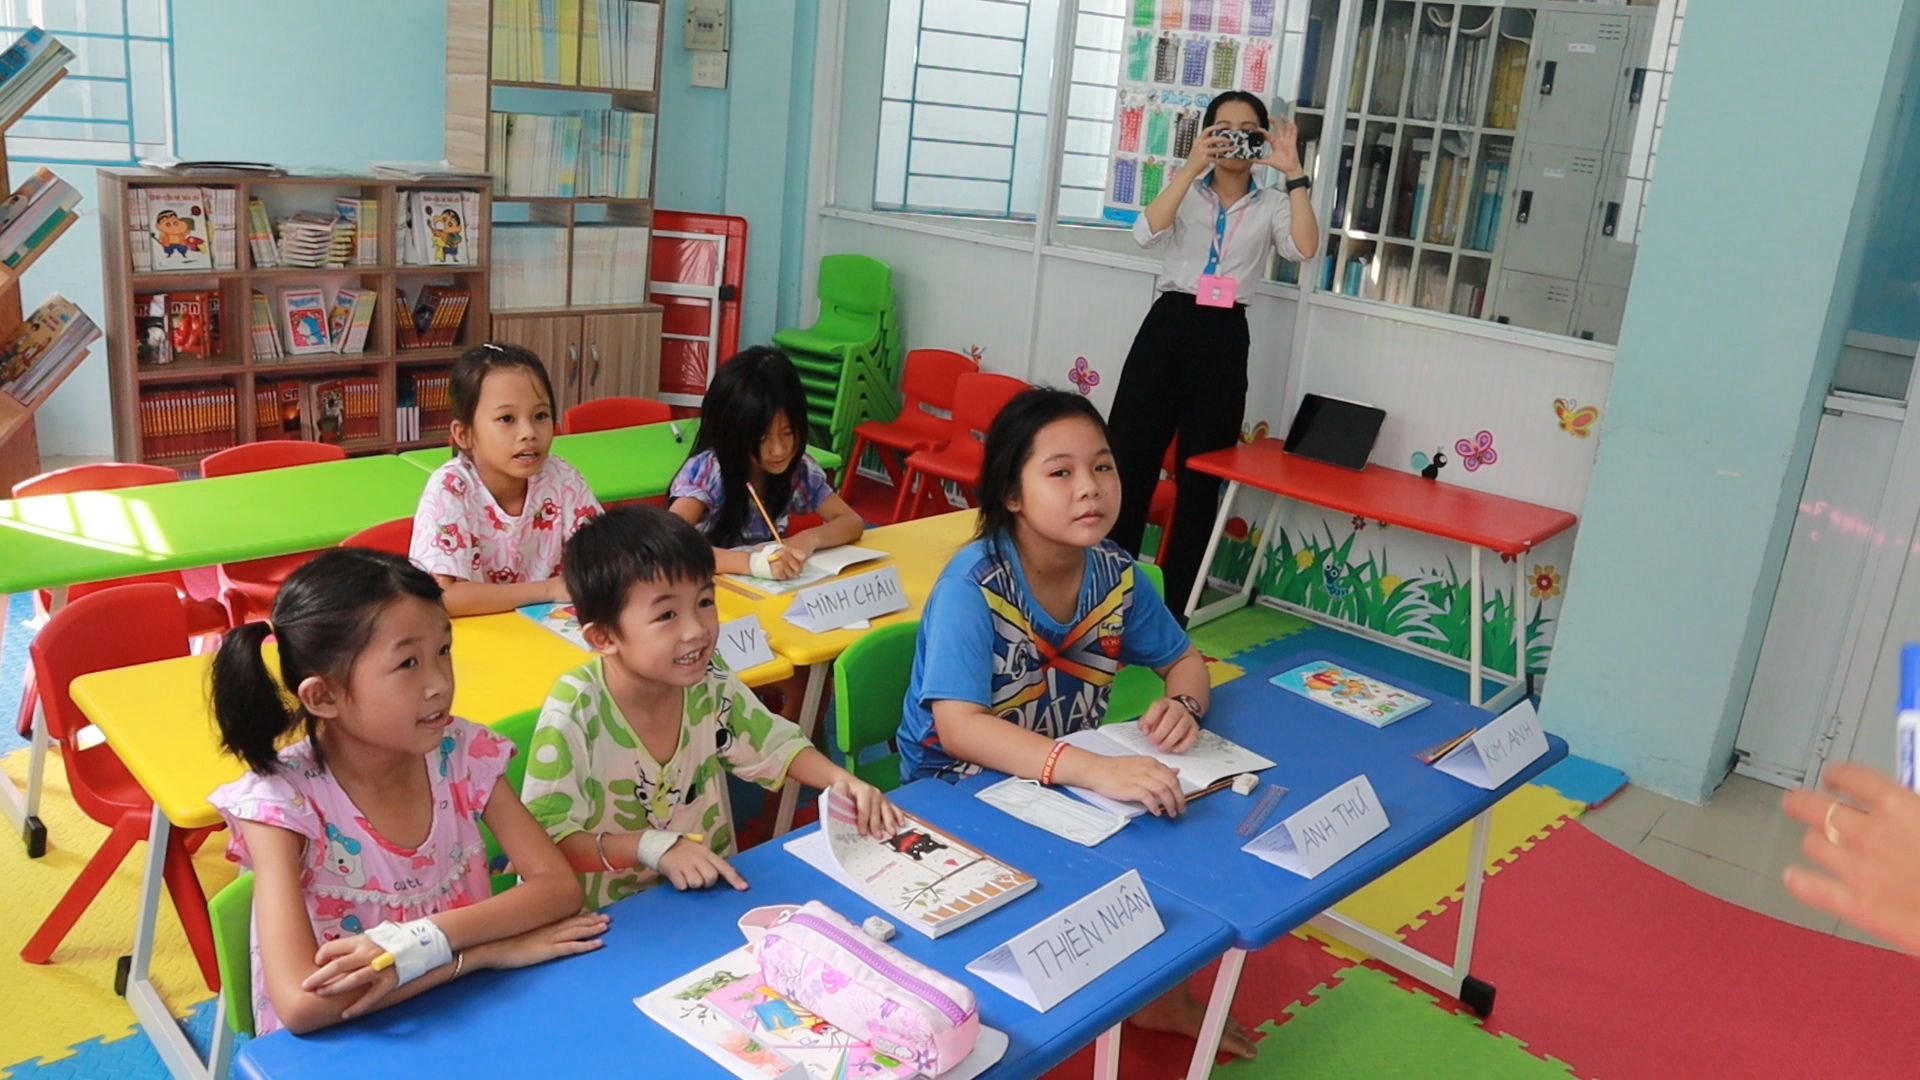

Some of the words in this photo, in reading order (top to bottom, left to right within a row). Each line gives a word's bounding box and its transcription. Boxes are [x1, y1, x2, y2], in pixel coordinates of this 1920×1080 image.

[727, 628, 756, 653] VY
[1507, 721, 1534, 752] ANH
[1302, 816, 1338, 856] ANH
[1097, 884, 1151, 936] NHÂN
